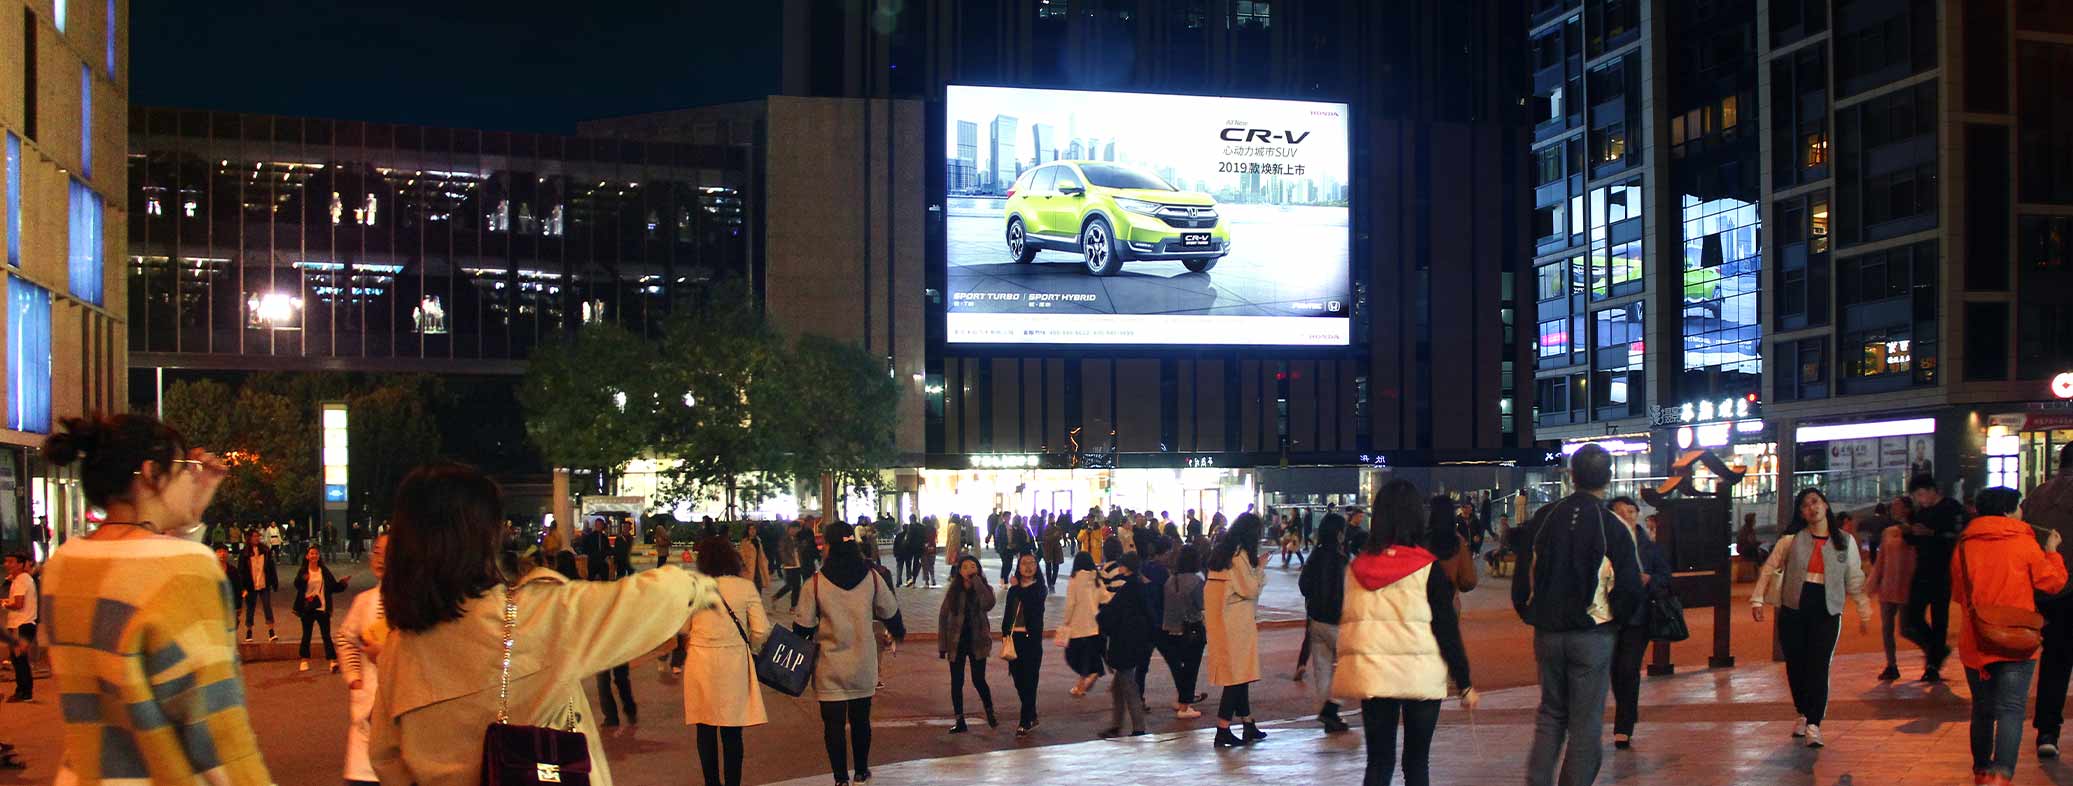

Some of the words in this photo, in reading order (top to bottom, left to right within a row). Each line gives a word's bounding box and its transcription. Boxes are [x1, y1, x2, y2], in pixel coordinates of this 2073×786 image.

[1220, 127, 1310, 144] CR-V
[953, 292, 986, 300] SPORT
[987, 293, 1020, 301] TURBO
[1028, 293, 1060, 301] SPORT
[1061, 294, 1096, 302] HYBRID
[772, 643, 804, 672] GAP
